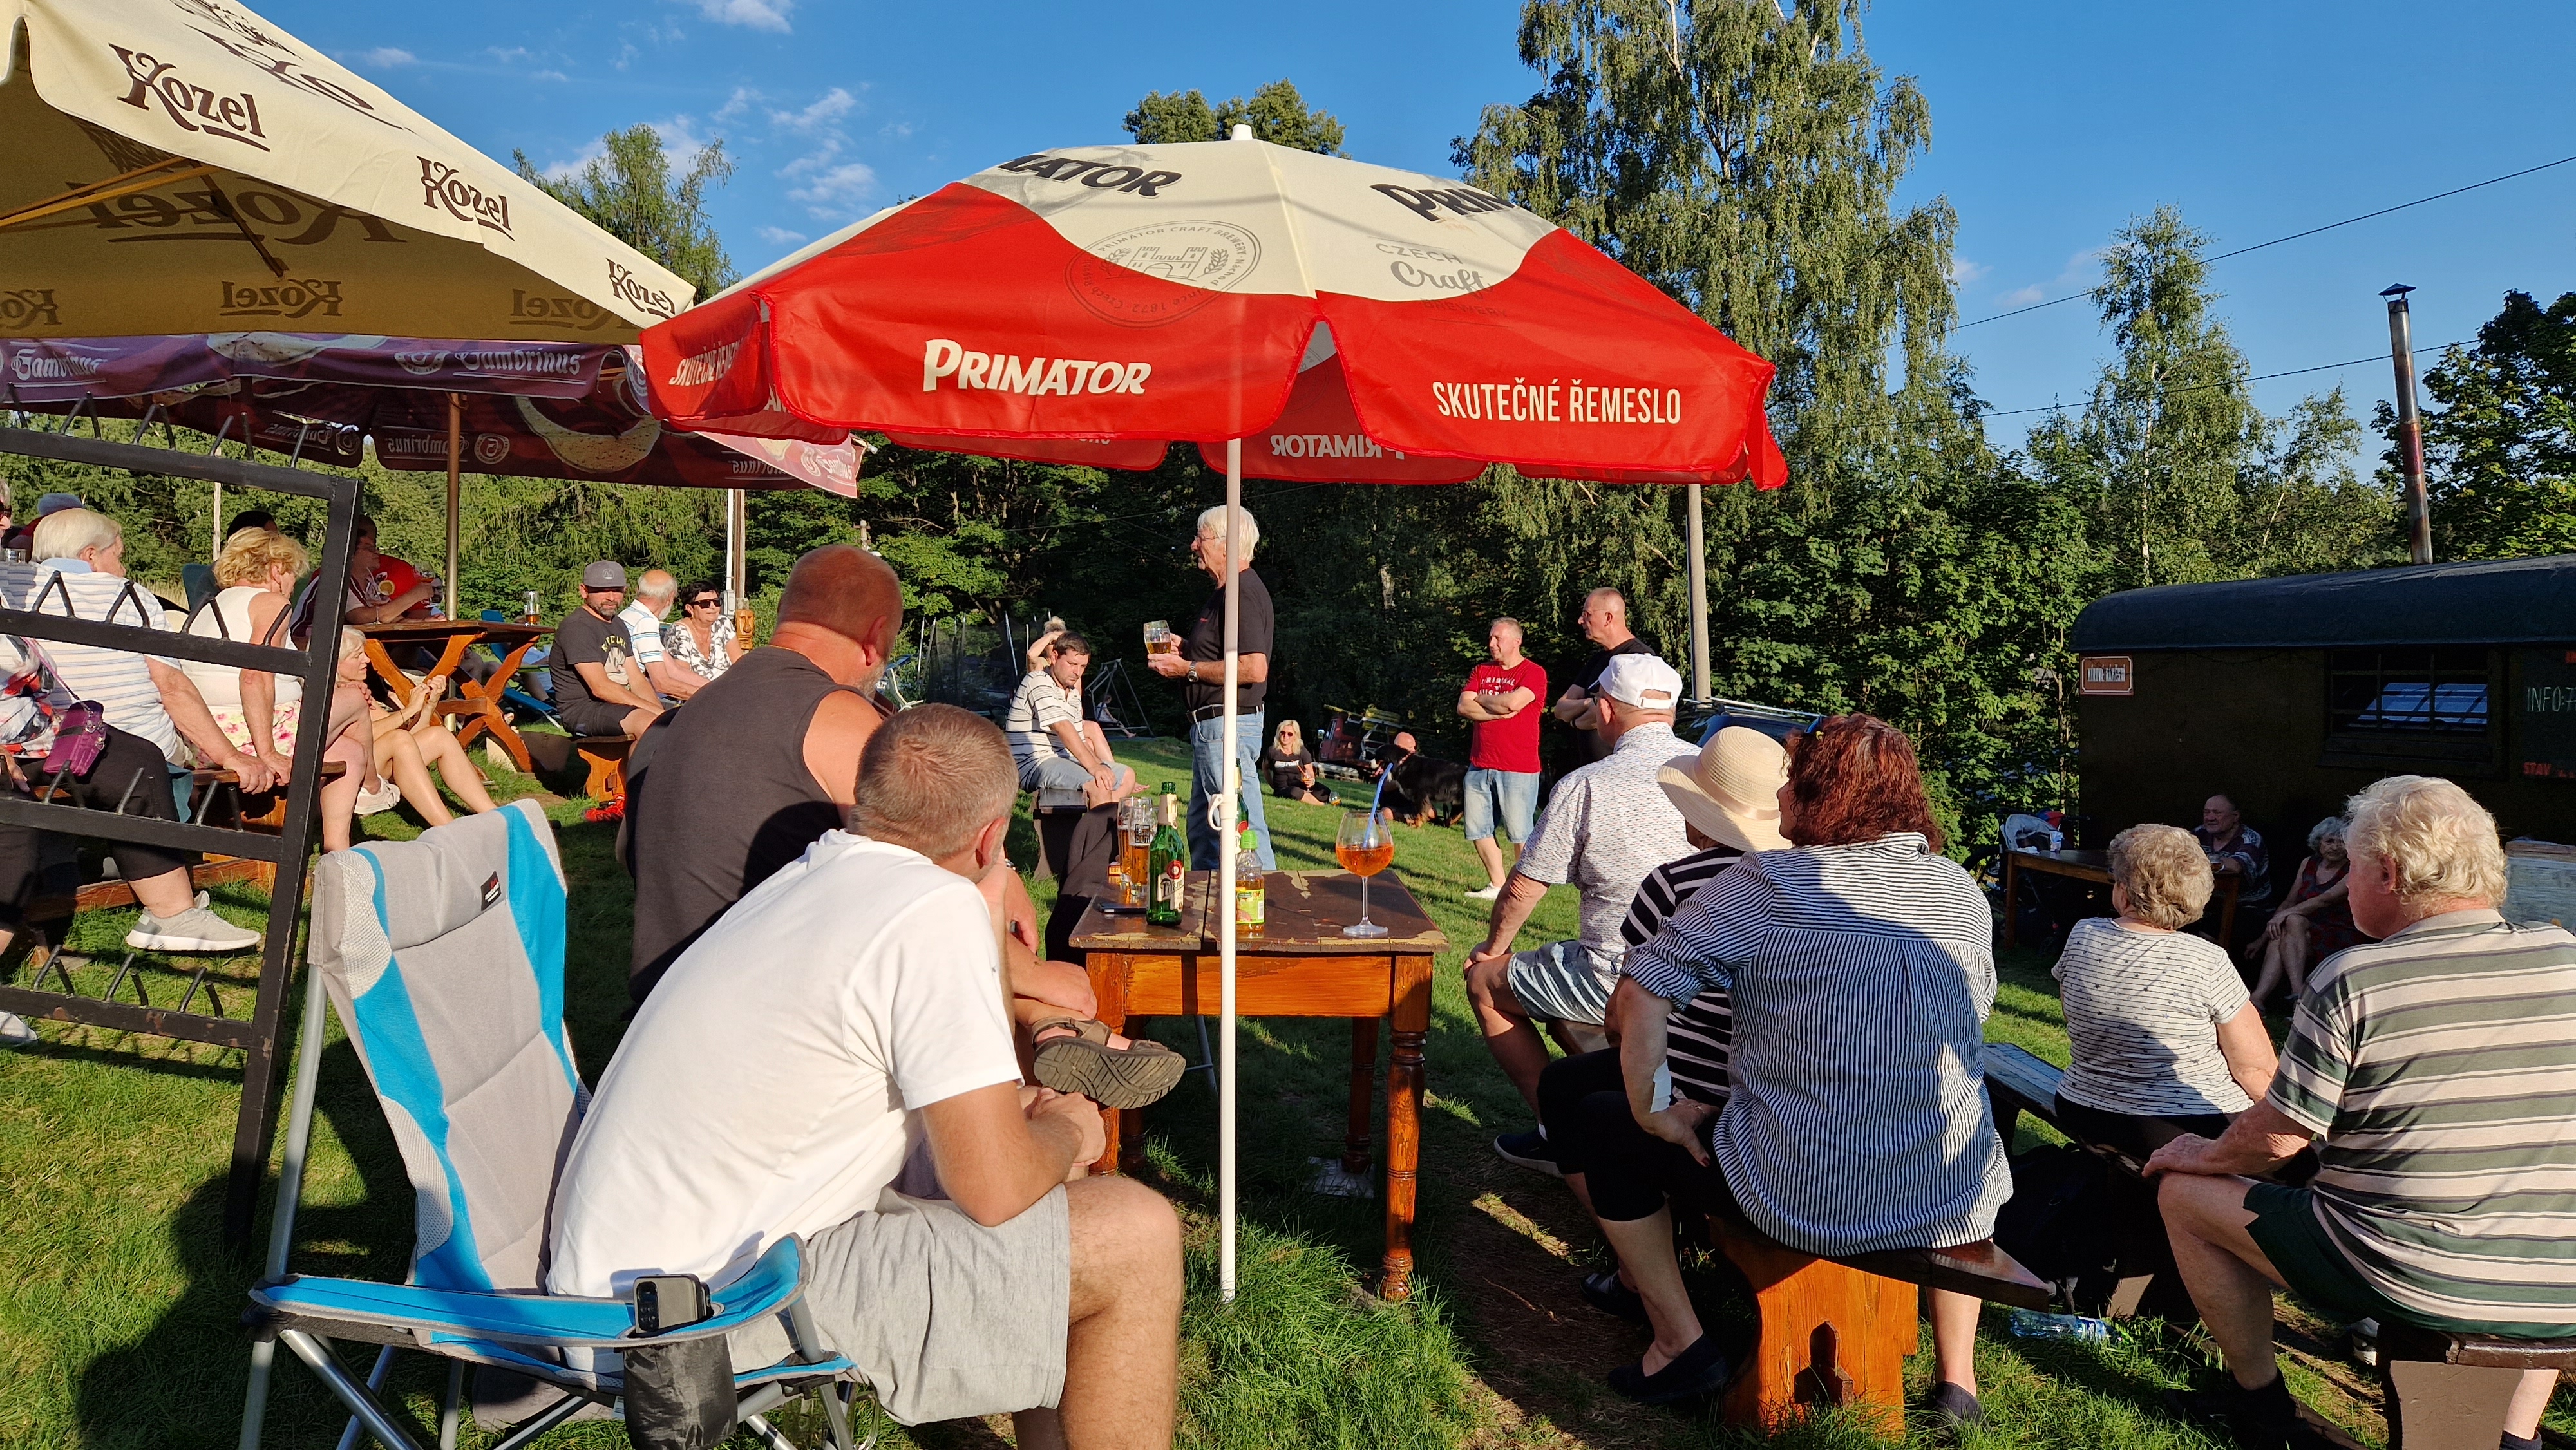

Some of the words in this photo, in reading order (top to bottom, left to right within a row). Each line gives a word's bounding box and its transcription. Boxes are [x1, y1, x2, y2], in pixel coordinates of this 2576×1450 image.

[108, 42, 270, 152] Kozel
[417, 155, 515, 241] Kozel
[1098, 228, 1165, 252] PRIMATOR
[1213, 229, 1247, 256] BREWERY
[1375, 243, 1464, 264] CZECH
[606, 258, 676, 319] Kozel
[1390, 261, 1494, 299] Craft
[1432, 377, 1561, 422] SKUTEČNÉ
[1569, 379, 1681, 424] ŘEMESLO
